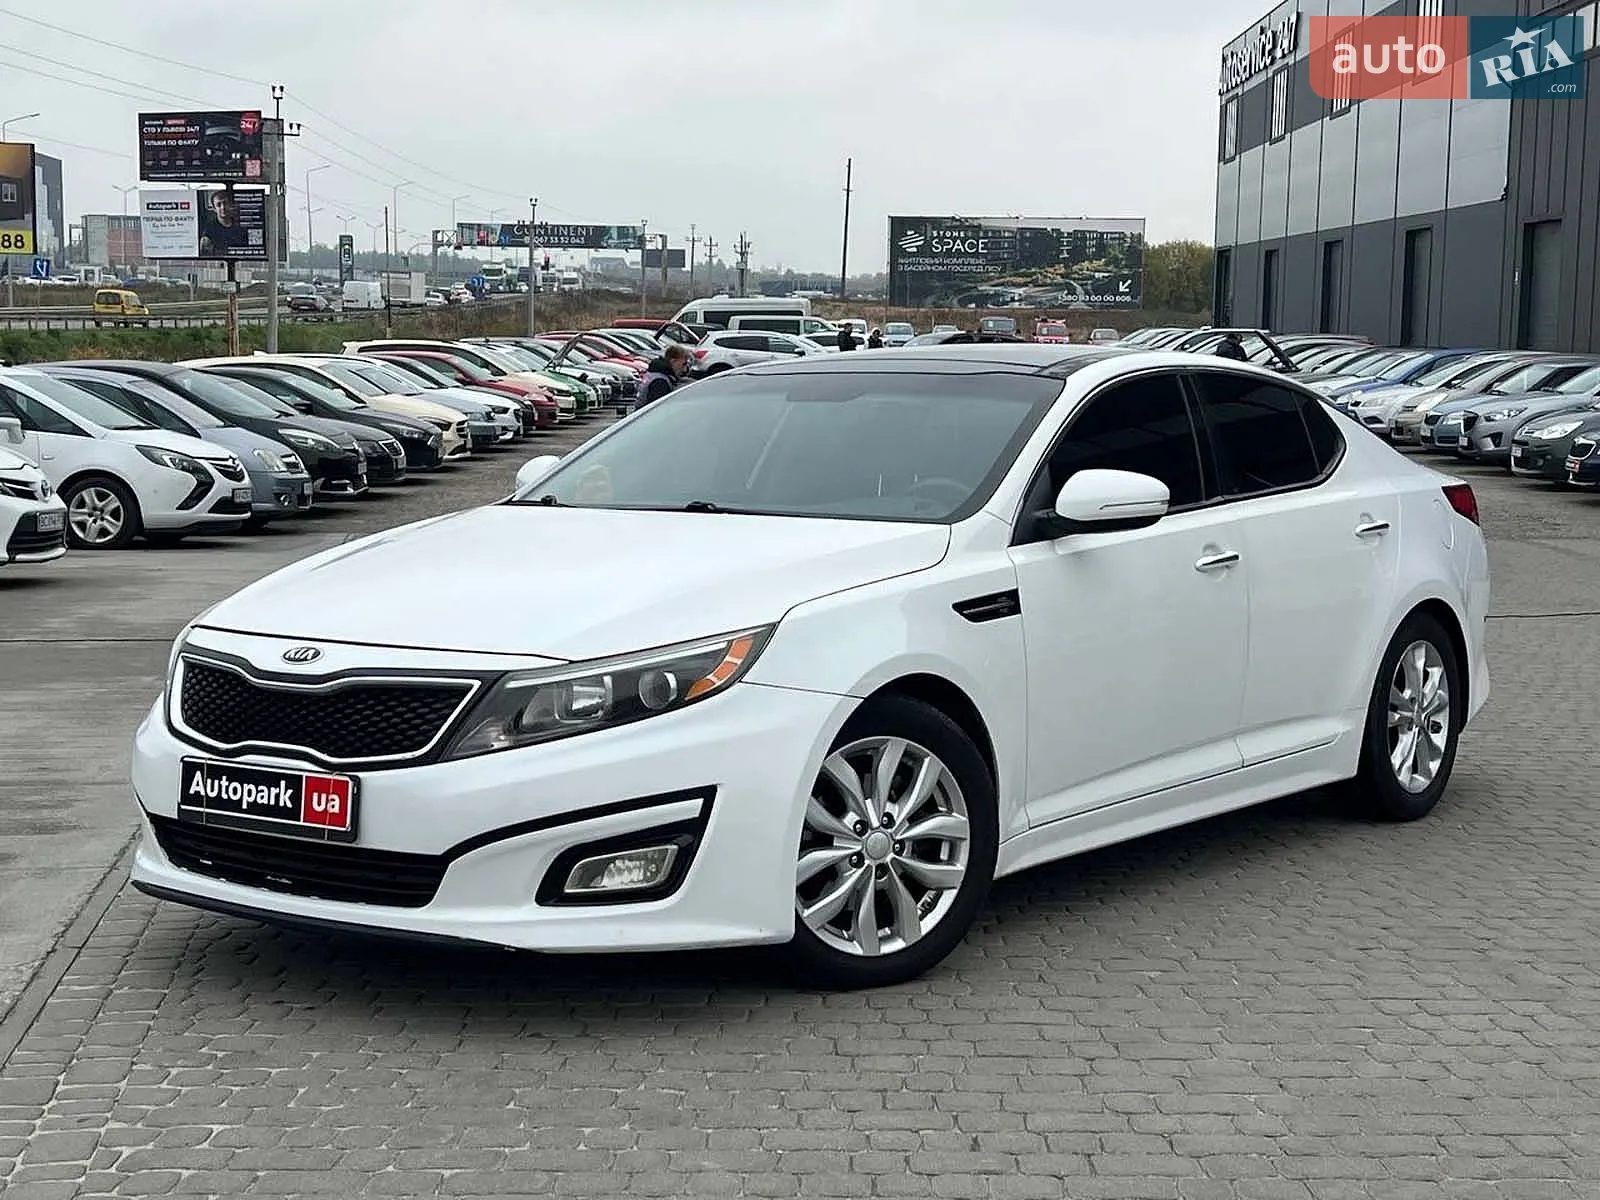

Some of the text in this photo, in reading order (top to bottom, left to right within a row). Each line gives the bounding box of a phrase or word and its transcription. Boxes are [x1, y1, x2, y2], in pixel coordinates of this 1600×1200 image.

[932, 239, 989, 253] SPACE
[284, 648, 320, 662] KIA
[189, 770, 340, 814] Autopark ua
